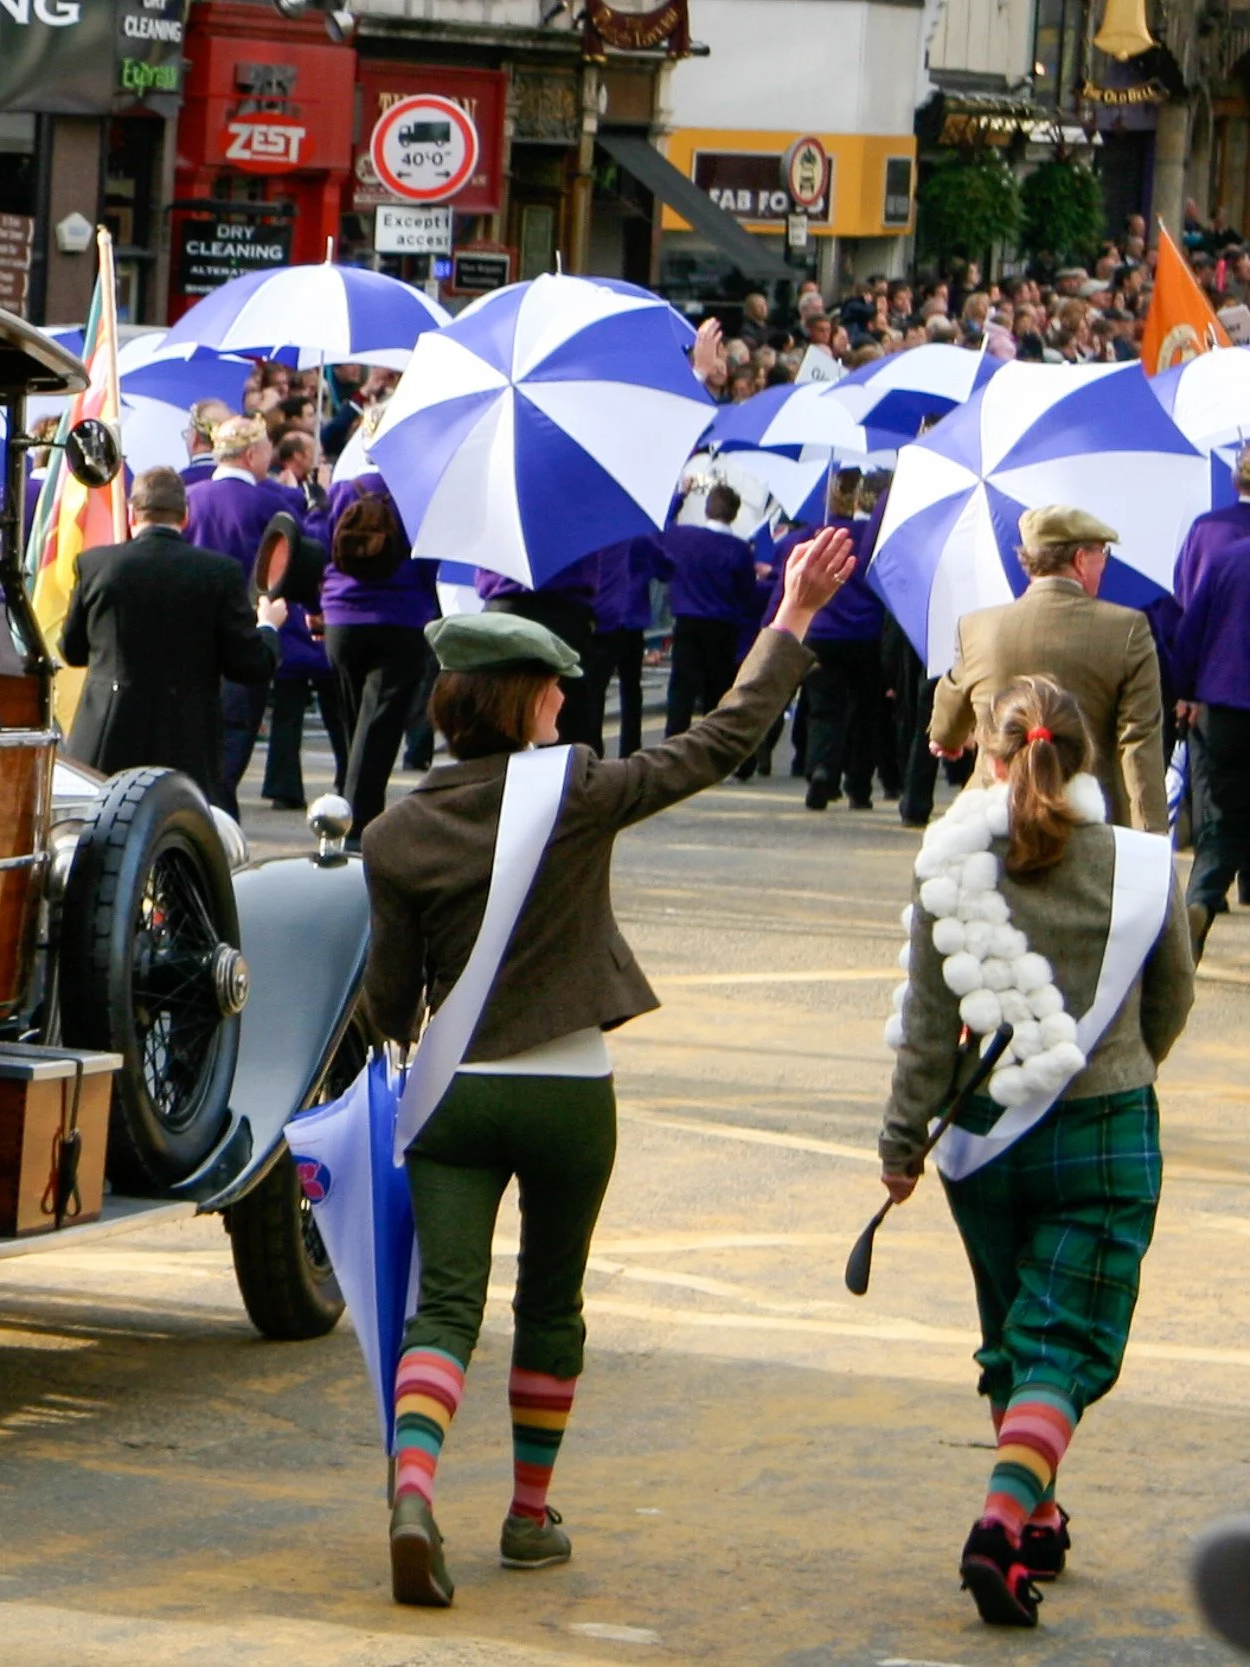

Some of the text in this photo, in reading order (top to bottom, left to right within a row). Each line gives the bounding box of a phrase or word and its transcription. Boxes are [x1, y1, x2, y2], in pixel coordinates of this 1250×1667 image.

[124, 15, 182, 43] CLEANING
[226, 122, 306, 163] ZEST
[384, 213, 440, 229] Except
[216, 224, 255, 239] DRY
[185, 240, 283, 260] CLEANING
